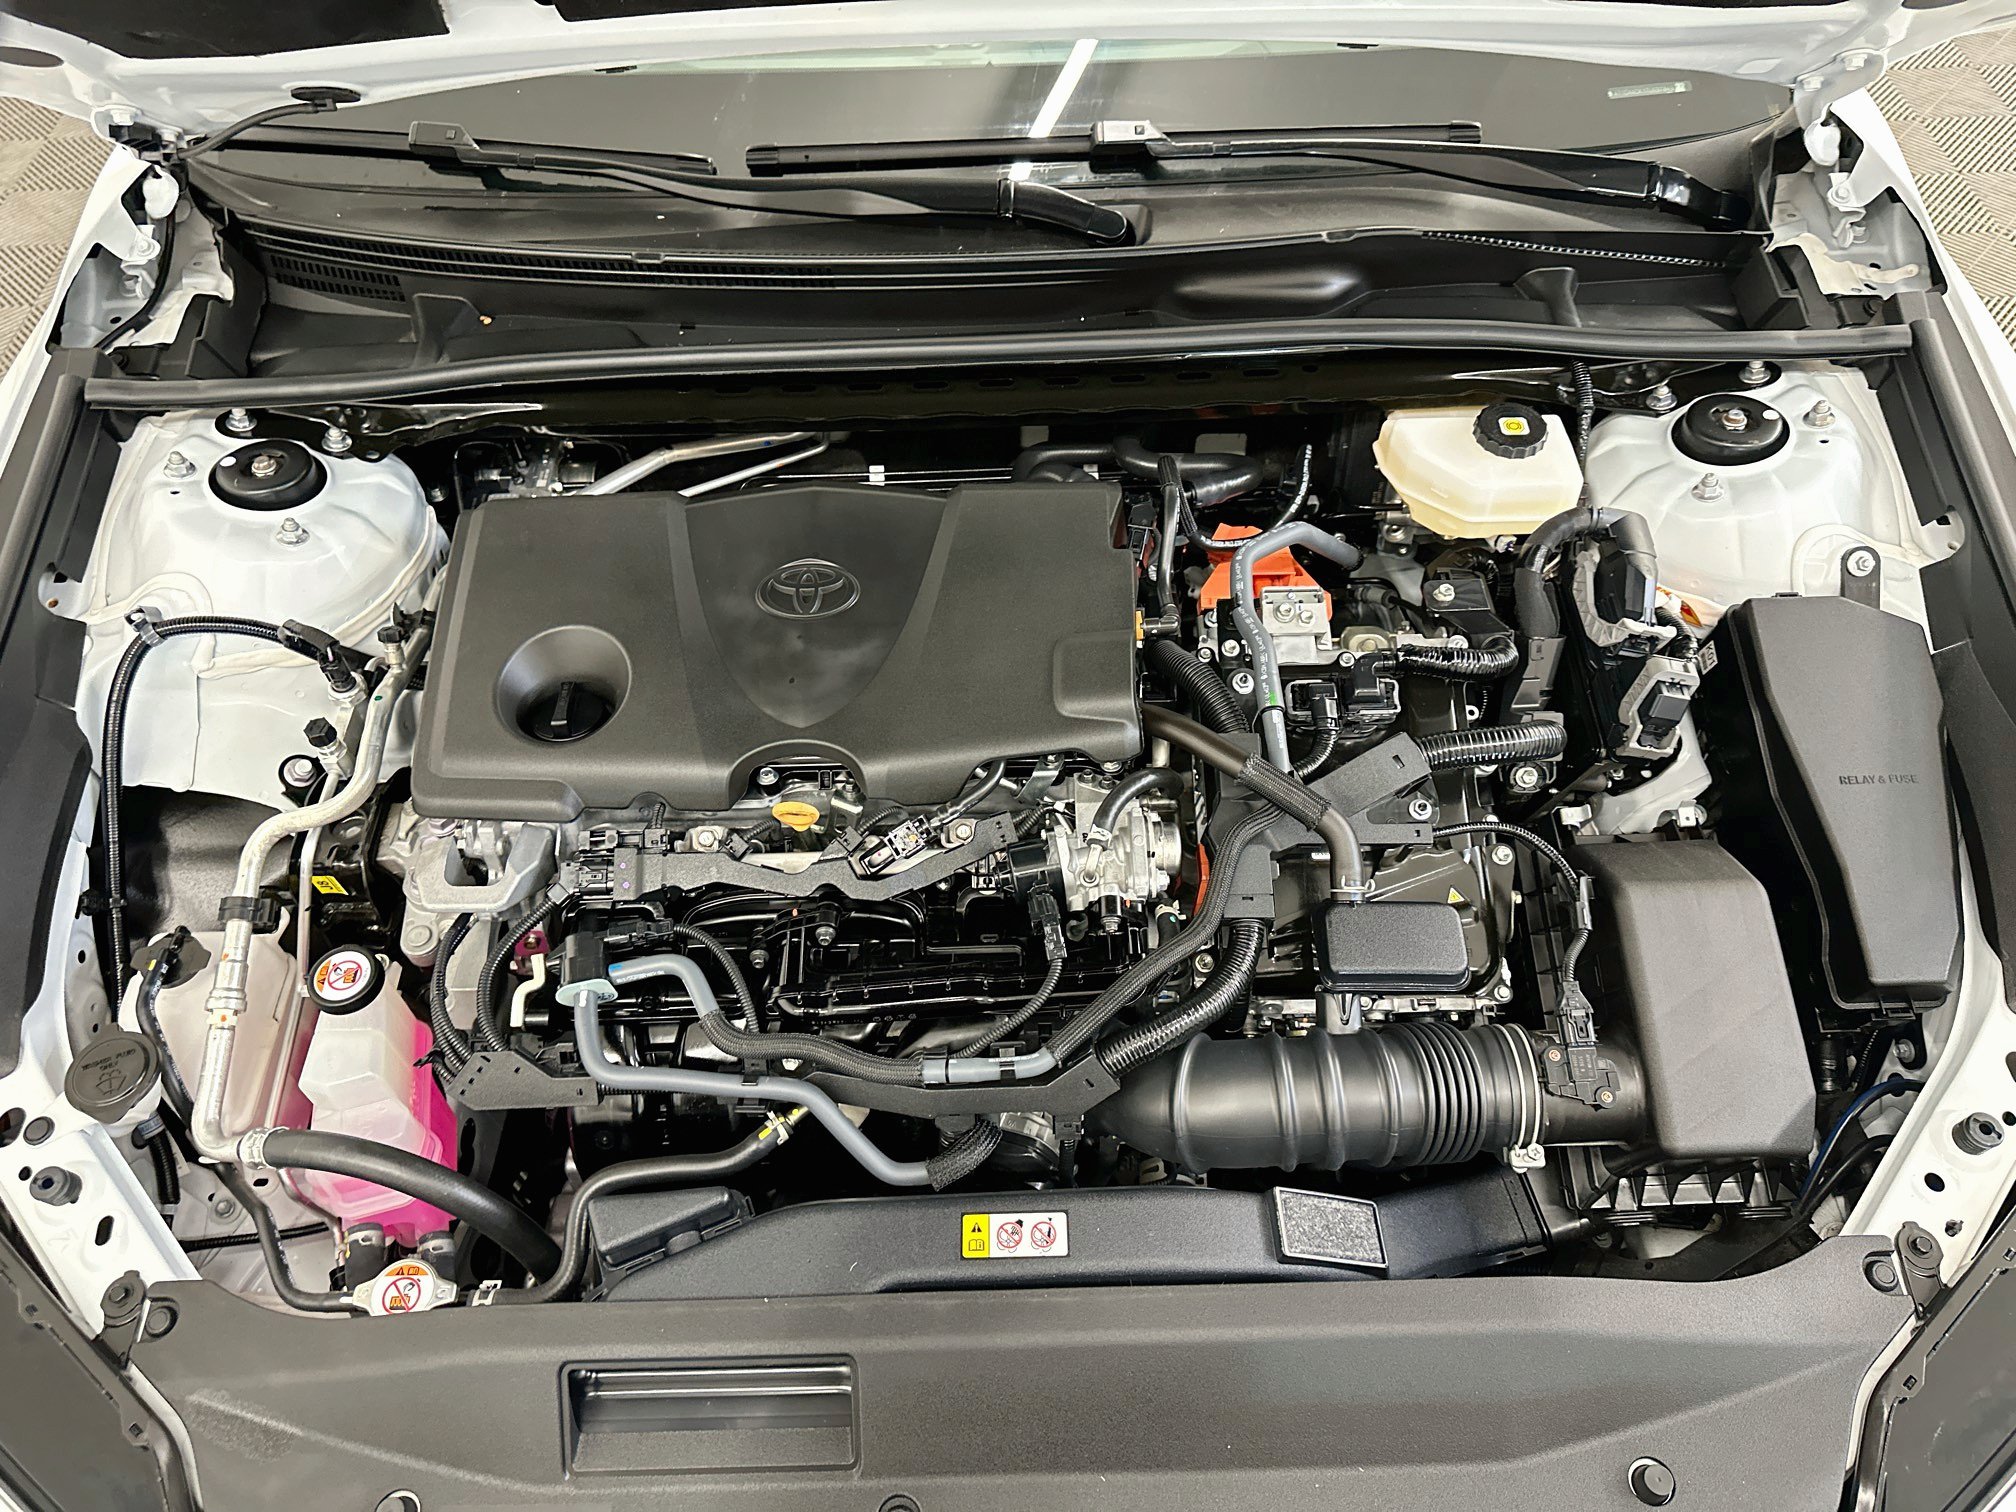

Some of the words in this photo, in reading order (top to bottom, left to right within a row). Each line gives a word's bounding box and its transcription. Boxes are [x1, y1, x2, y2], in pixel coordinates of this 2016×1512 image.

[1839, 775, 1875, 785] RELAY
[1878, 775, 1886, 785] &
[1888, 774, 1919, 784] FUSE
